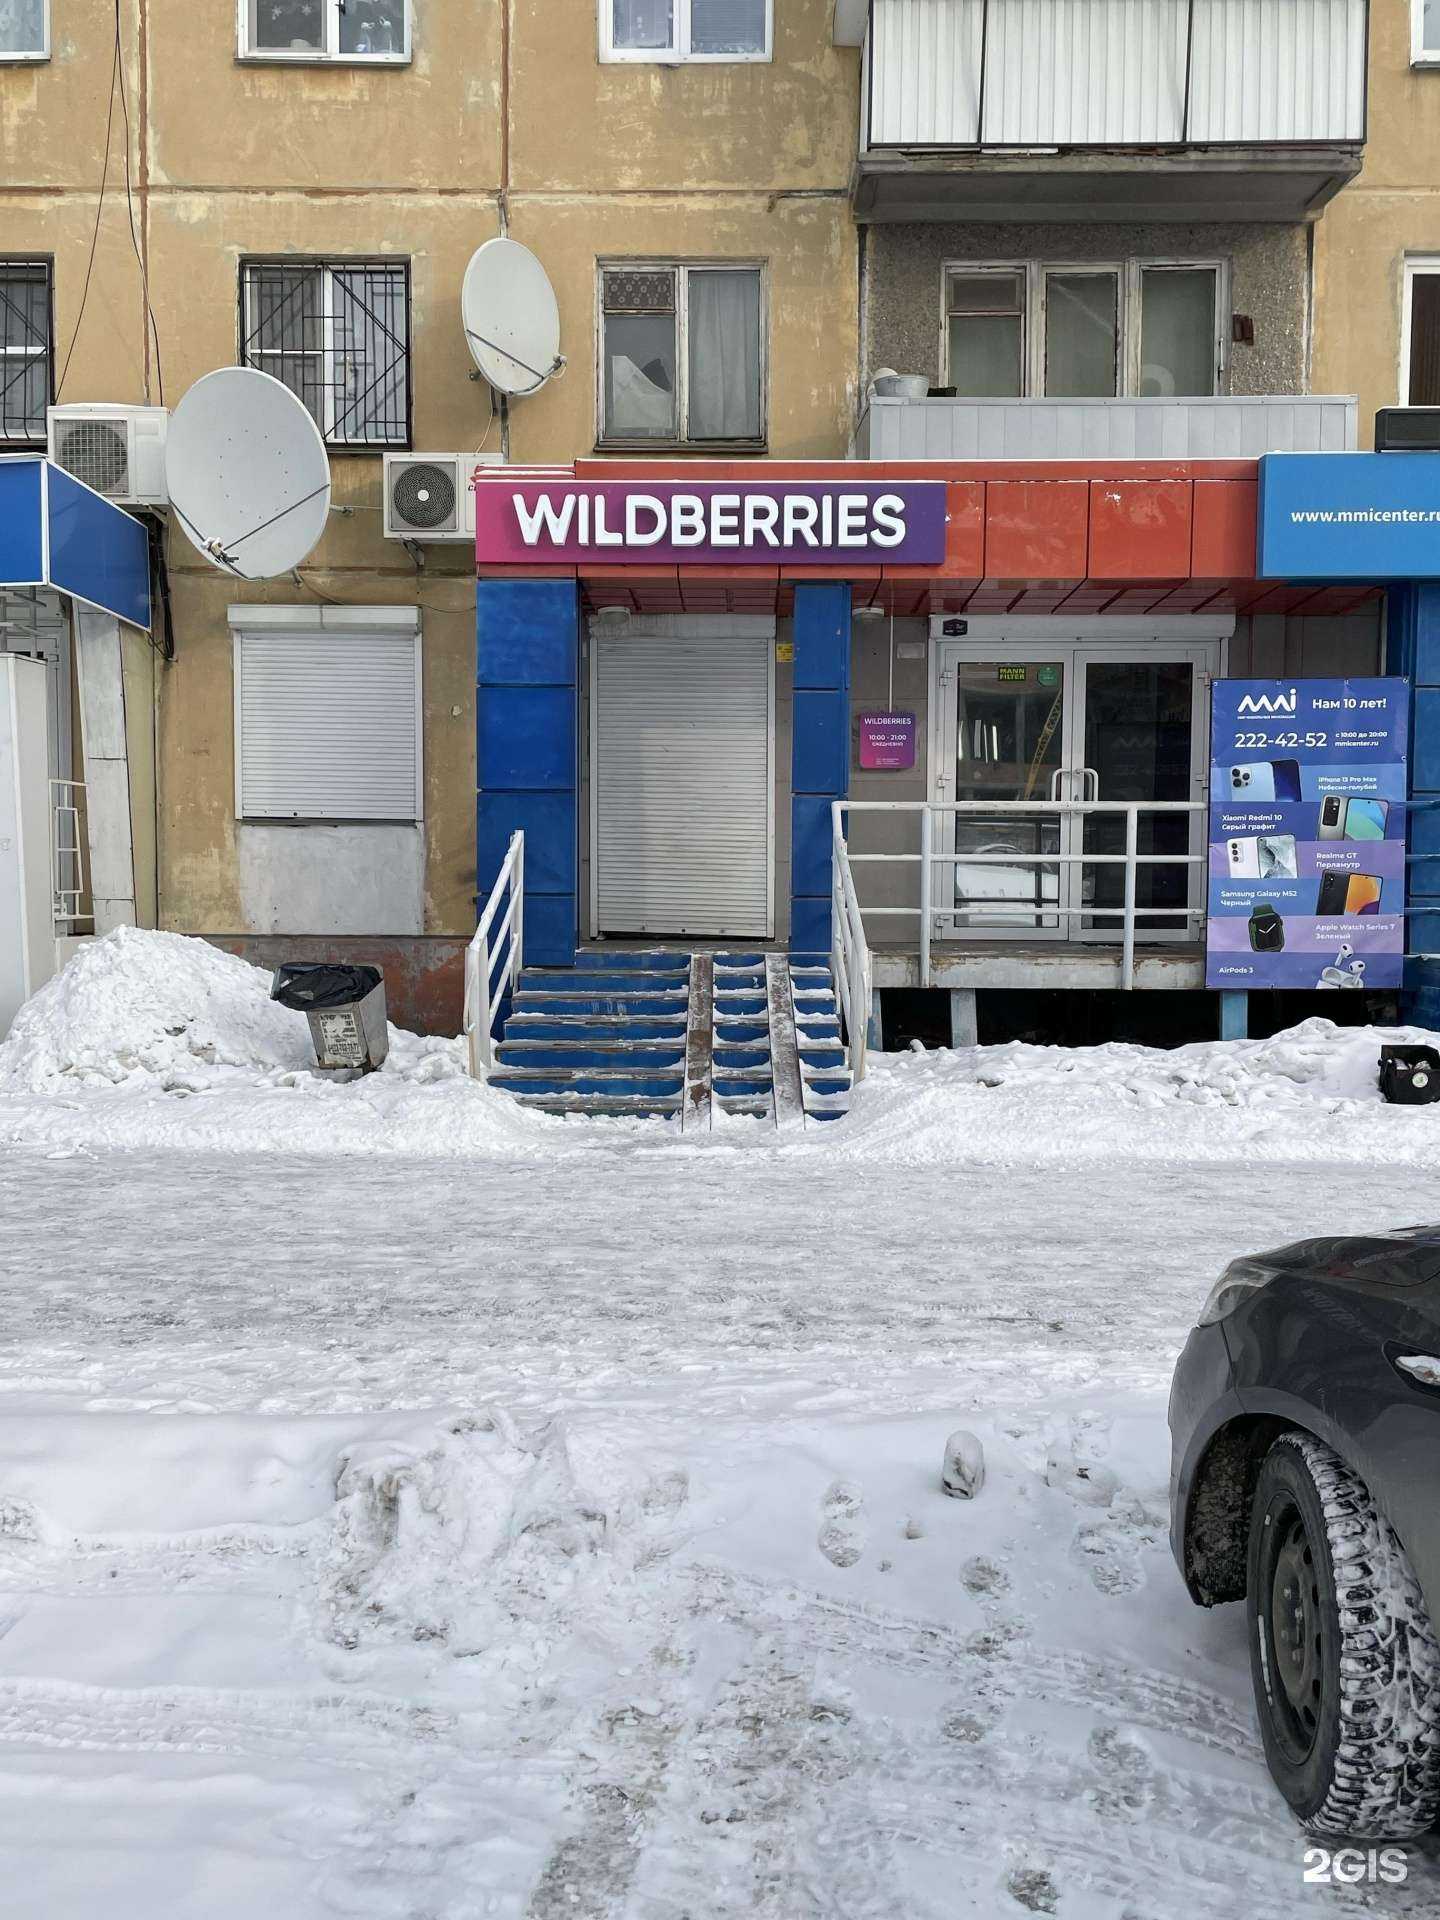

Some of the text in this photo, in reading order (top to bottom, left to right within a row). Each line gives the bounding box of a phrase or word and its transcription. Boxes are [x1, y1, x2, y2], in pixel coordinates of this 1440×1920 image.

[512, 494, 906, 547] WILDBERRIES
[1312, 698, 1387, 709] Нам 10 лет!
[864, 717, 911, 725] WILDBERRIES
[1234, 732, 1328, 748] 222-42-52
[1221, 823, 1247, 831] Серый
[1316, 861, 1361, 869] Перламутр
[1220, 890, 1256, 898] Samsung
[1256, 890, 1281, 898] Galaxy
[1220, 899, 1252, 907] Черный
[1315, 924, 1339, 932] Apple
[1366, 923, 1389, 931] Series
[1219, 966, 1248, 974] AirPods
